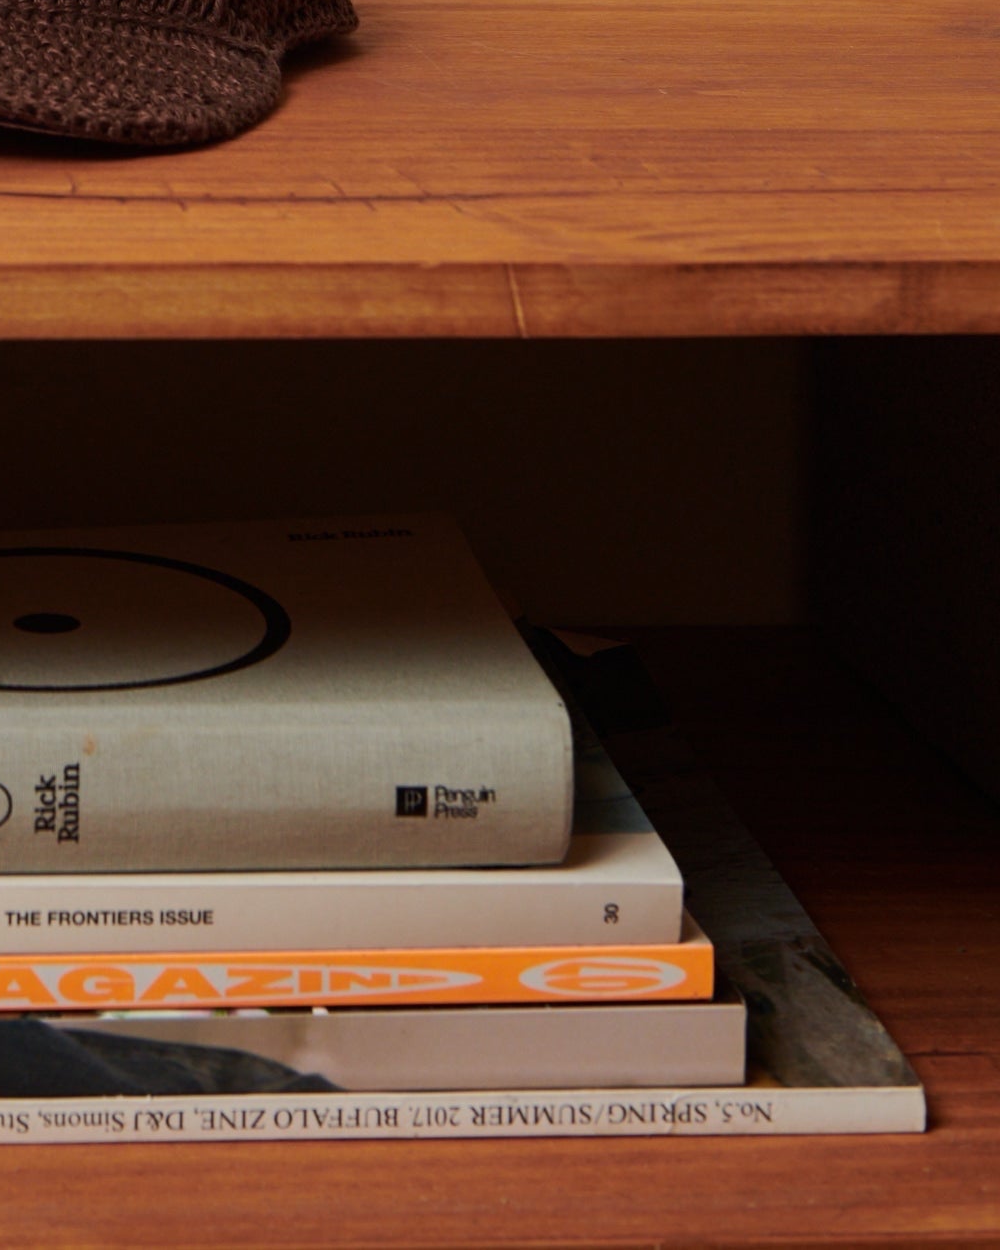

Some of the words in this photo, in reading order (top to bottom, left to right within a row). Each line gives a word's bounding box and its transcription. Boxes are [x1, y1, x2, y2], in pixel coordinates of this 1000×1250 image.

[34, 774, 56, 833] Rick
[58, 762, 79, 844] Rubin
[434, 784, 496, 806] Penguin
[5, 911, 42, 926] THE
[47, 911, 154, 926] FRONTIERS
[160, 910, 214, 925] ISSUE
[603, 903, 619, 924] 30
[37, 1108, 126, 1133] Simons,
[134, 1110, 185, 1132] D&J
[193, 1107, 266, 1130] ZINE,
[274, 1107, 399, 1130] BUFFALO
[472, 1102, 707, 1125] SPRING/SUMMER
[715, 1100, 773, 1123] No.5,
